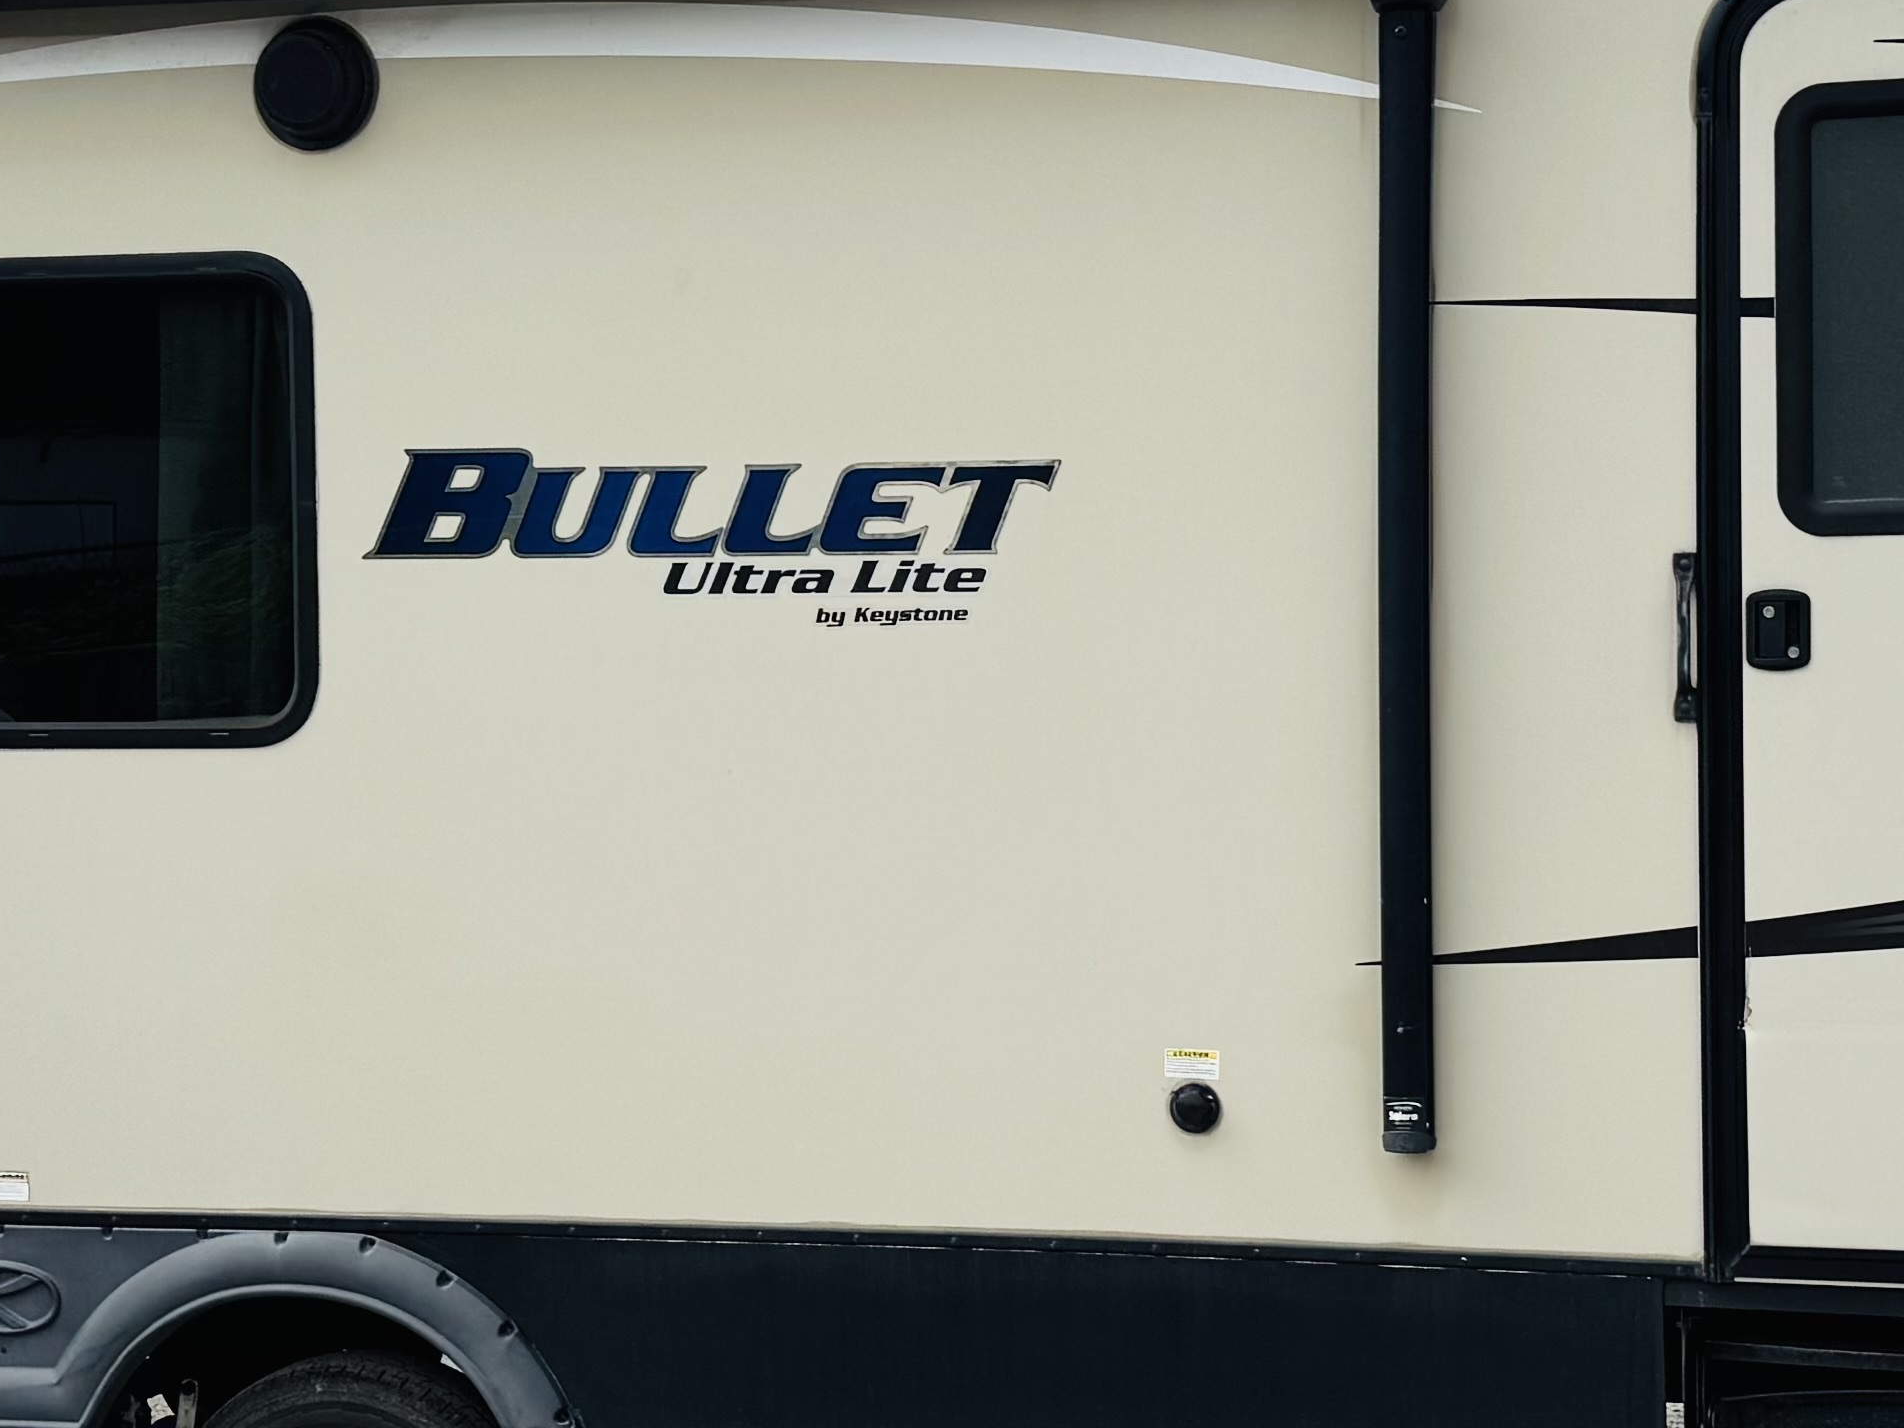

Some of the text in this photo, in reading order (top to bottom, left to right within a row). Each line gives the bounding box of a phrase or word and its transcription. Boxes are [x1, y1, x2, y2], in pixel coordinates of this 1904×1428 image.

[362, 447, 1062, 559] BULLET
[663, 559, 987, 595] Ultra Lite
[815, 607, 969, 627] by Keystone
